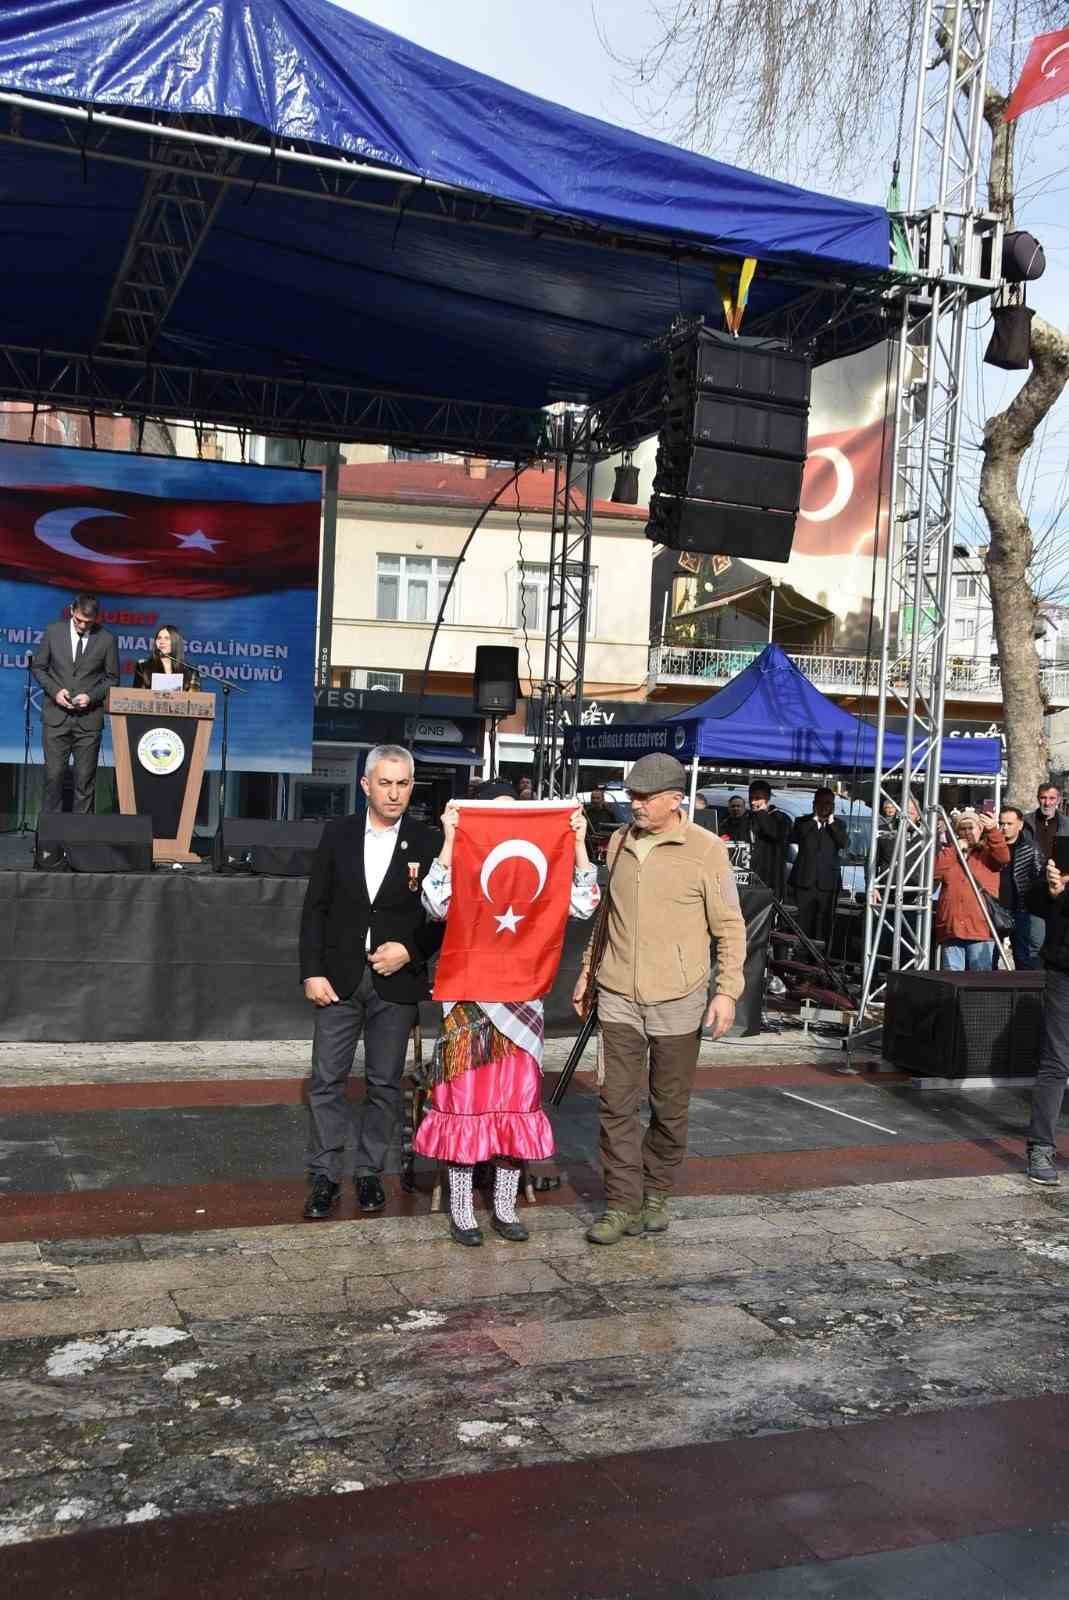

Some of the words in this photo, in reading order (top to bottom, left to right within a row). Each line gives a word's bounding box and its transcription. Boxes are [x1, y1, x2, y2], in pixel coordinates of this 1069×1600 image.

[95, 609, 160, 625] UBAT
[198, 661, 283, 682] DÖNÜMÜ
[418, 725, 444, 737] QNB
[624, 728, 668, 748] BELEDİYESİ
